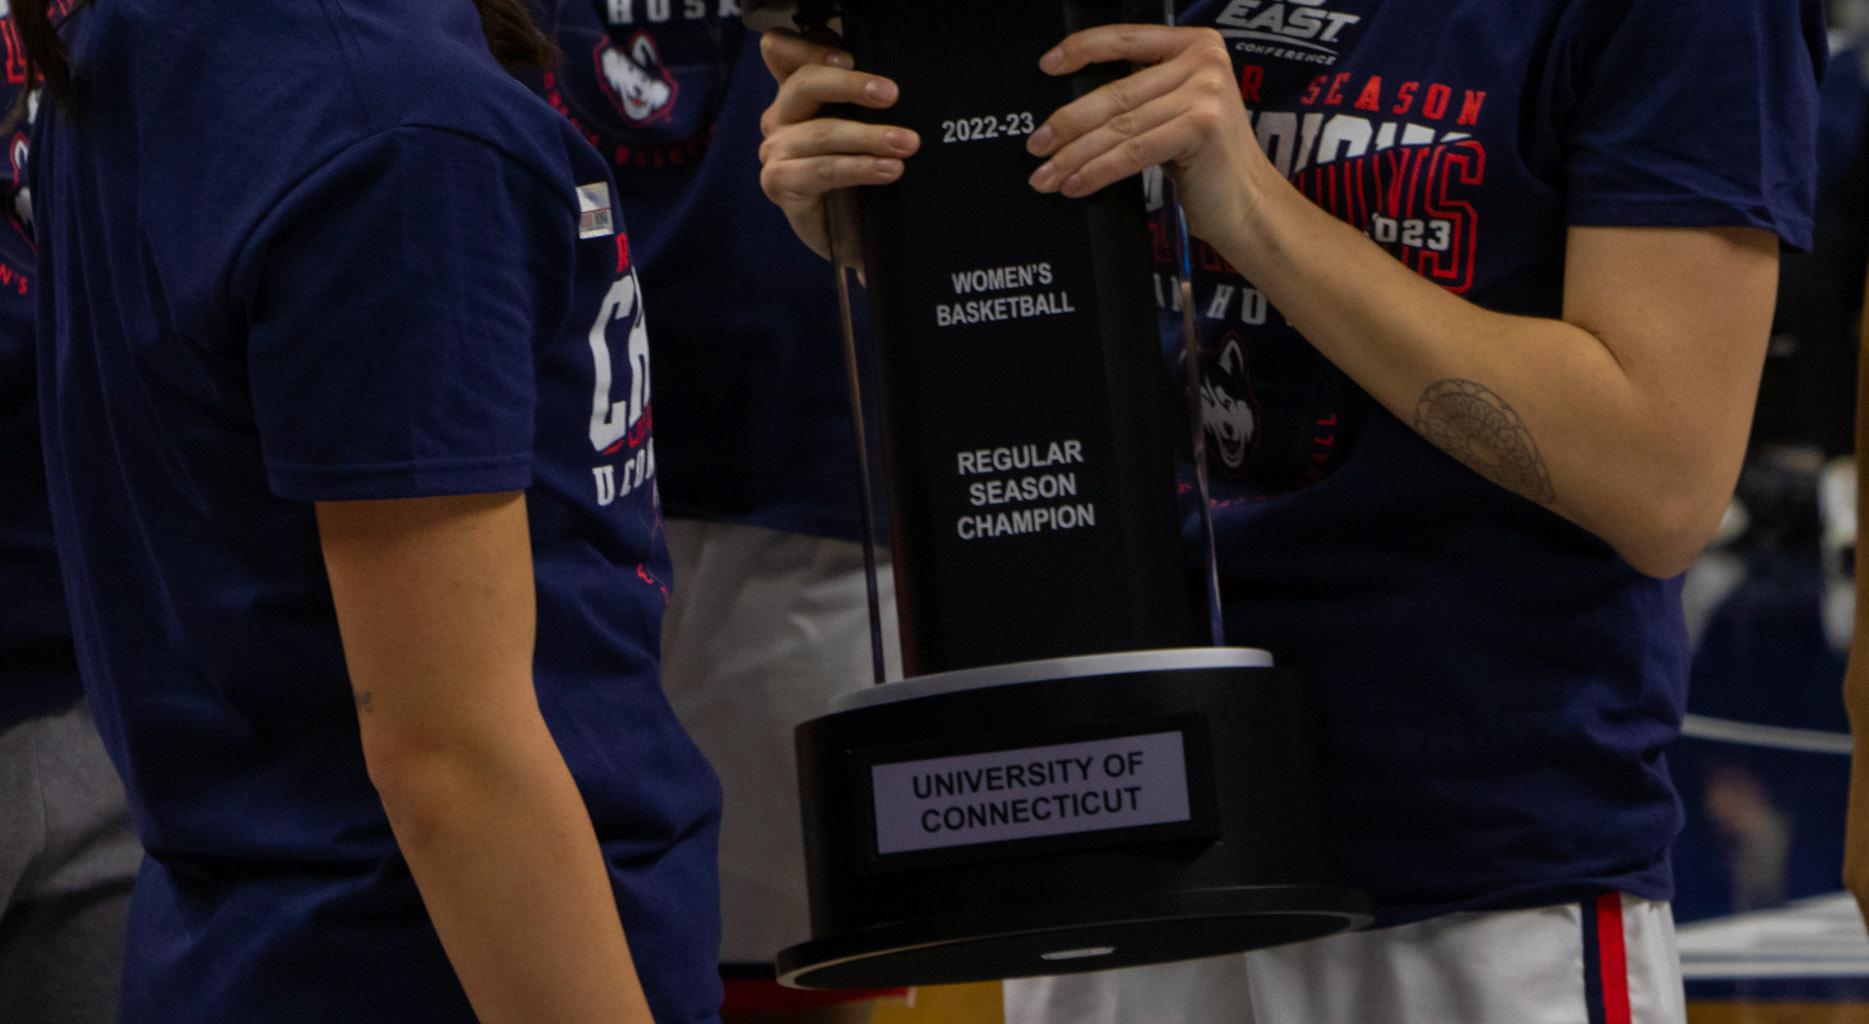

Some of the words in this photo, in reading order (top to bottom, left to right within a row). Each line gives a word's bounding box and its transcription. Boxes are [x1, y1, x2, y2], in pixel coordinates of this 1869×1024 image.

[1234, 40, 1338, 66] CONFERENCE
[1300, 71, 1487, 126] SEASON
[941, 111, 1035, 144] 2022-23
[1363, 211, 1451, 252] 023
[950, 261, 1053, 295] WOMEN'S
[935, 290, 1076, 327] BASKETBALL
[957, 438, 1085, 476] REGULAR
[969, 472, 1078, 507] SEASON
[956, 501, 1096, 541] CHAMPION
[912, 756, 1094, 800] UNIVERSITY
[1103, 750, 1144, 778] OF
[921, 786, 1142, 833] CONNECTICUT
